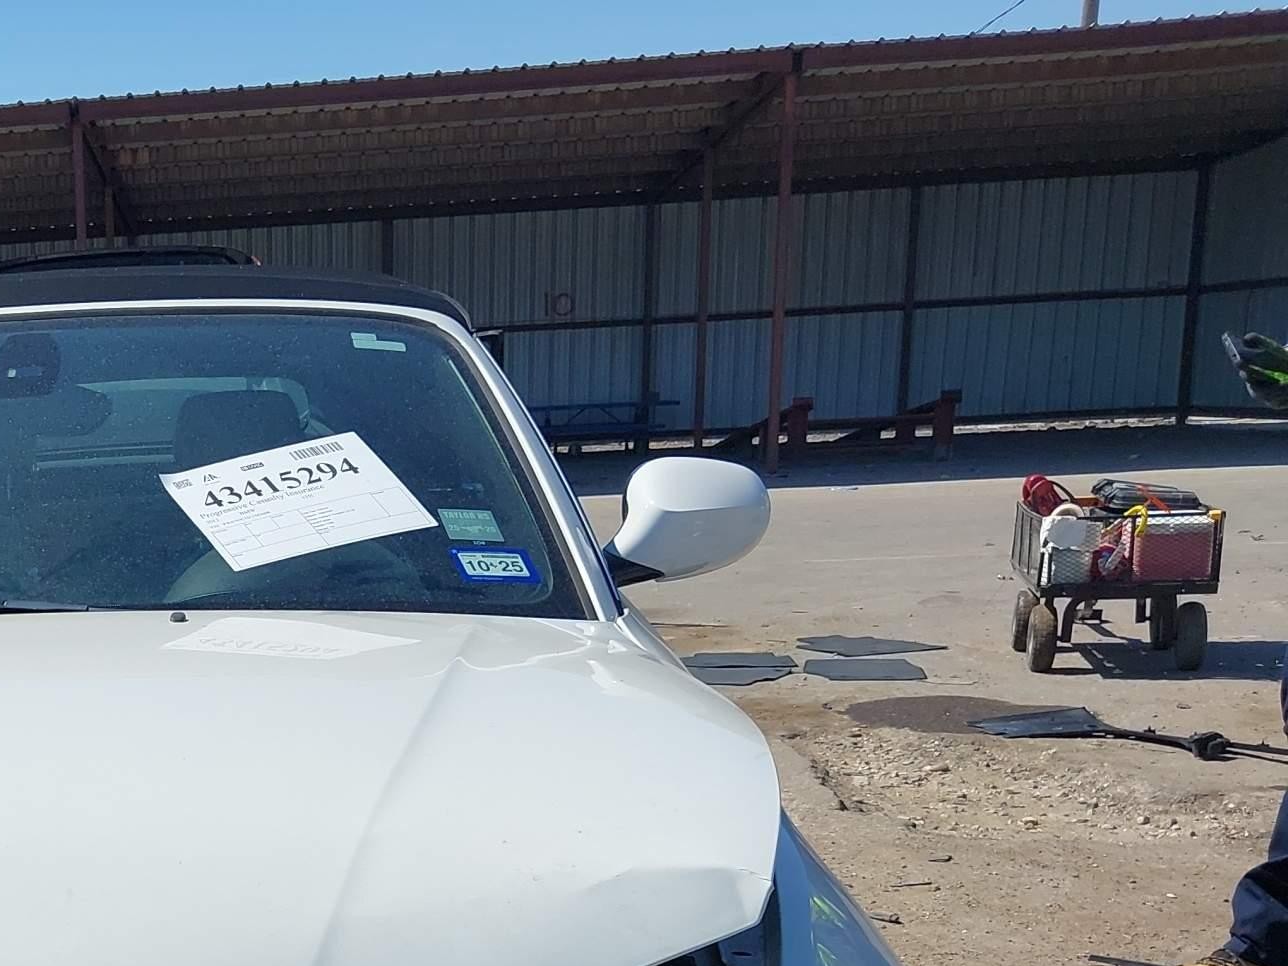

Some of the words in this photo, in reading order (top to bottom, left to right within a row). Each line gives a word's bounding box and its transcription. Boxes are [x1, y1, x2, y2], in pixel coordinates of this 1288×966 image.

[204, 457, 360, 508] 43415294
[200, 503, 248, 520] Progressive
[442, 511, 476, 520] TAYLOR
[466, 560, 490, 572] 10
[498, 560, 524, 573] 25
